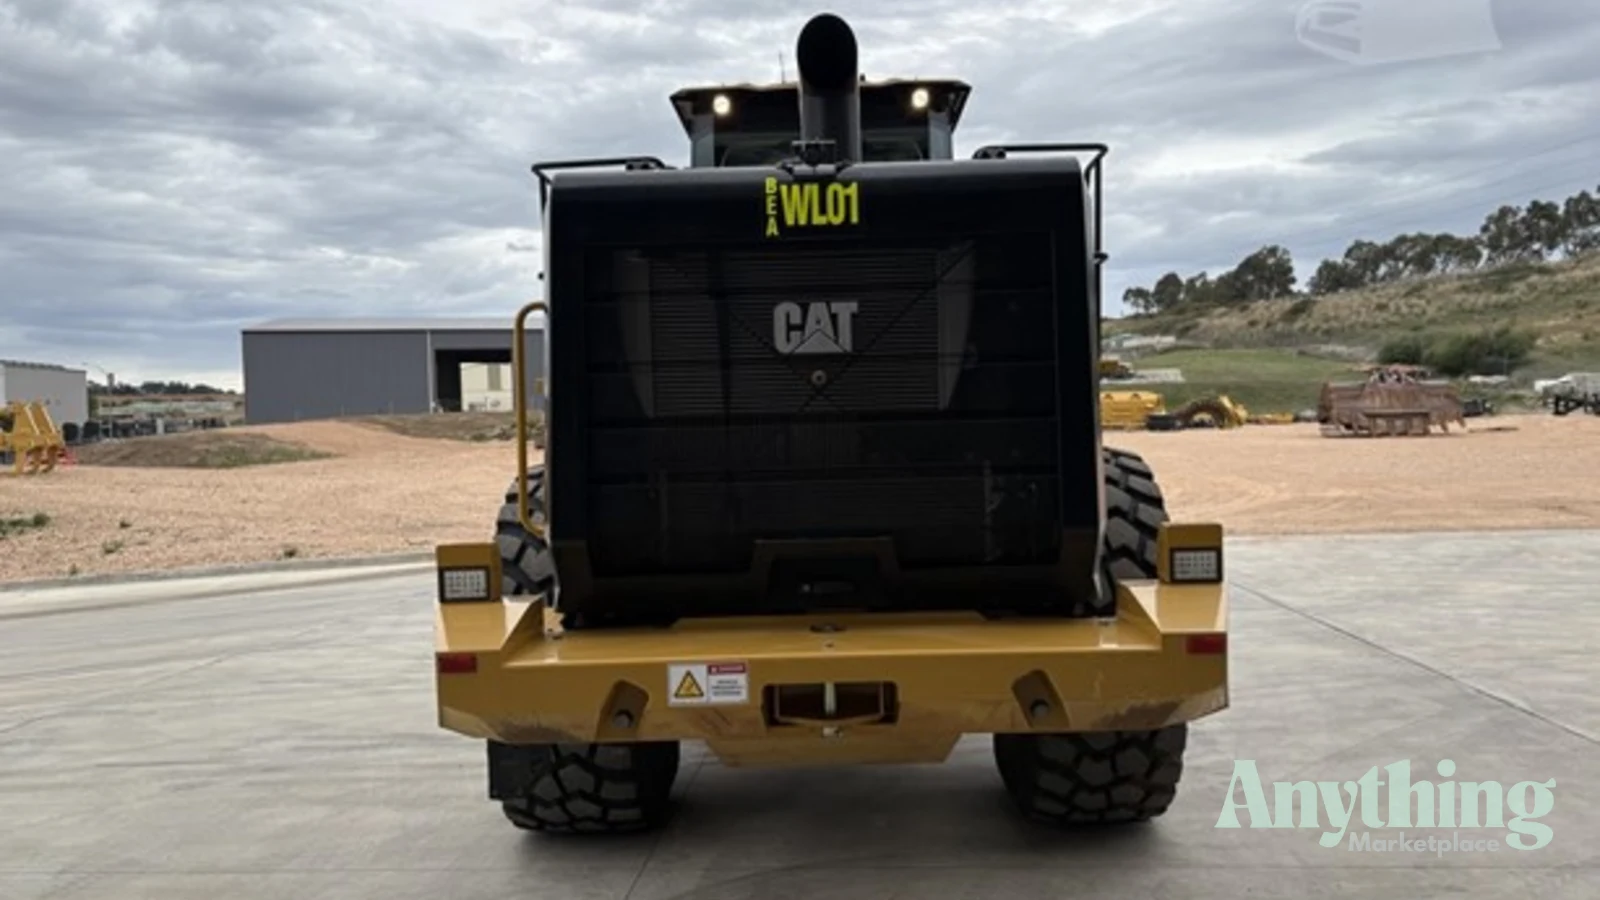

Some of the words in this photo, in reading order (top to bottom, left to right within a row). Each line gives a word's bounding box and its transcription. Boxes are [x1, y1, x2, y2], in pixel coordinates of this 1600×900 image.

[765, 176, 779, 236] BEA
[780, 182, 858, 226] WL01
[773, 301, 858, 354] CAT
